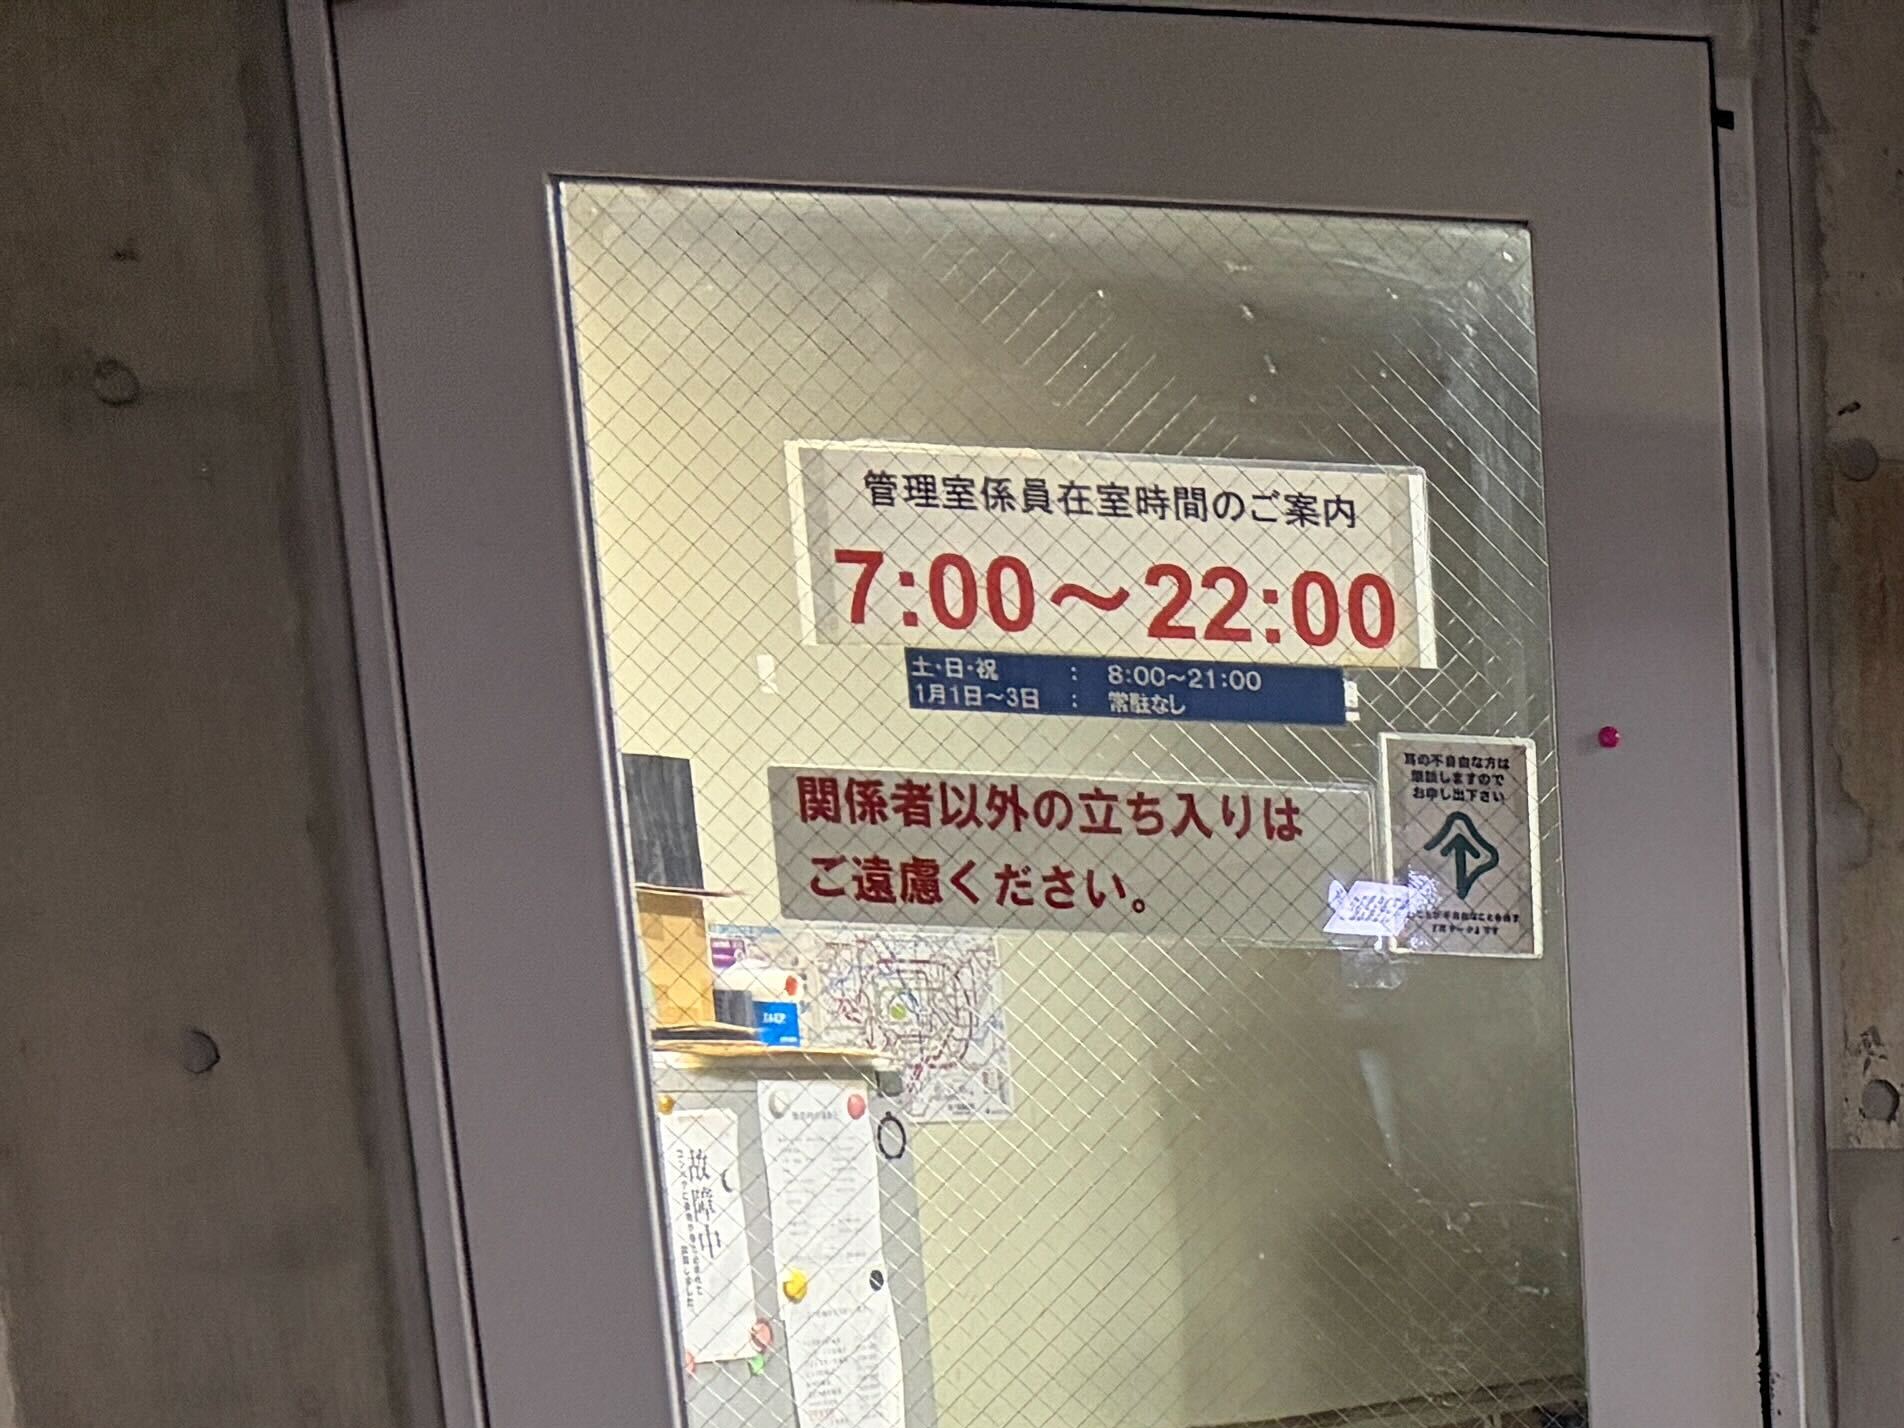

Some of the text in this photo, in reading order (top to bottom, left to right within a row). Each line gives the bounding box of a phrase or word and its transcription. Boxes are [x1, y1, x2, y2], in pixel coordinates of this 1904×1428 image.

[862, 469, 1358, 530] 管理室係員在室時間のご案内
[1108, 690, 1186, 717] 常駐なし
[796, 776, 1303, 843] 関係者以外の立ち入りは
[808, 857, 1156, 914] ご遠慮ください。
